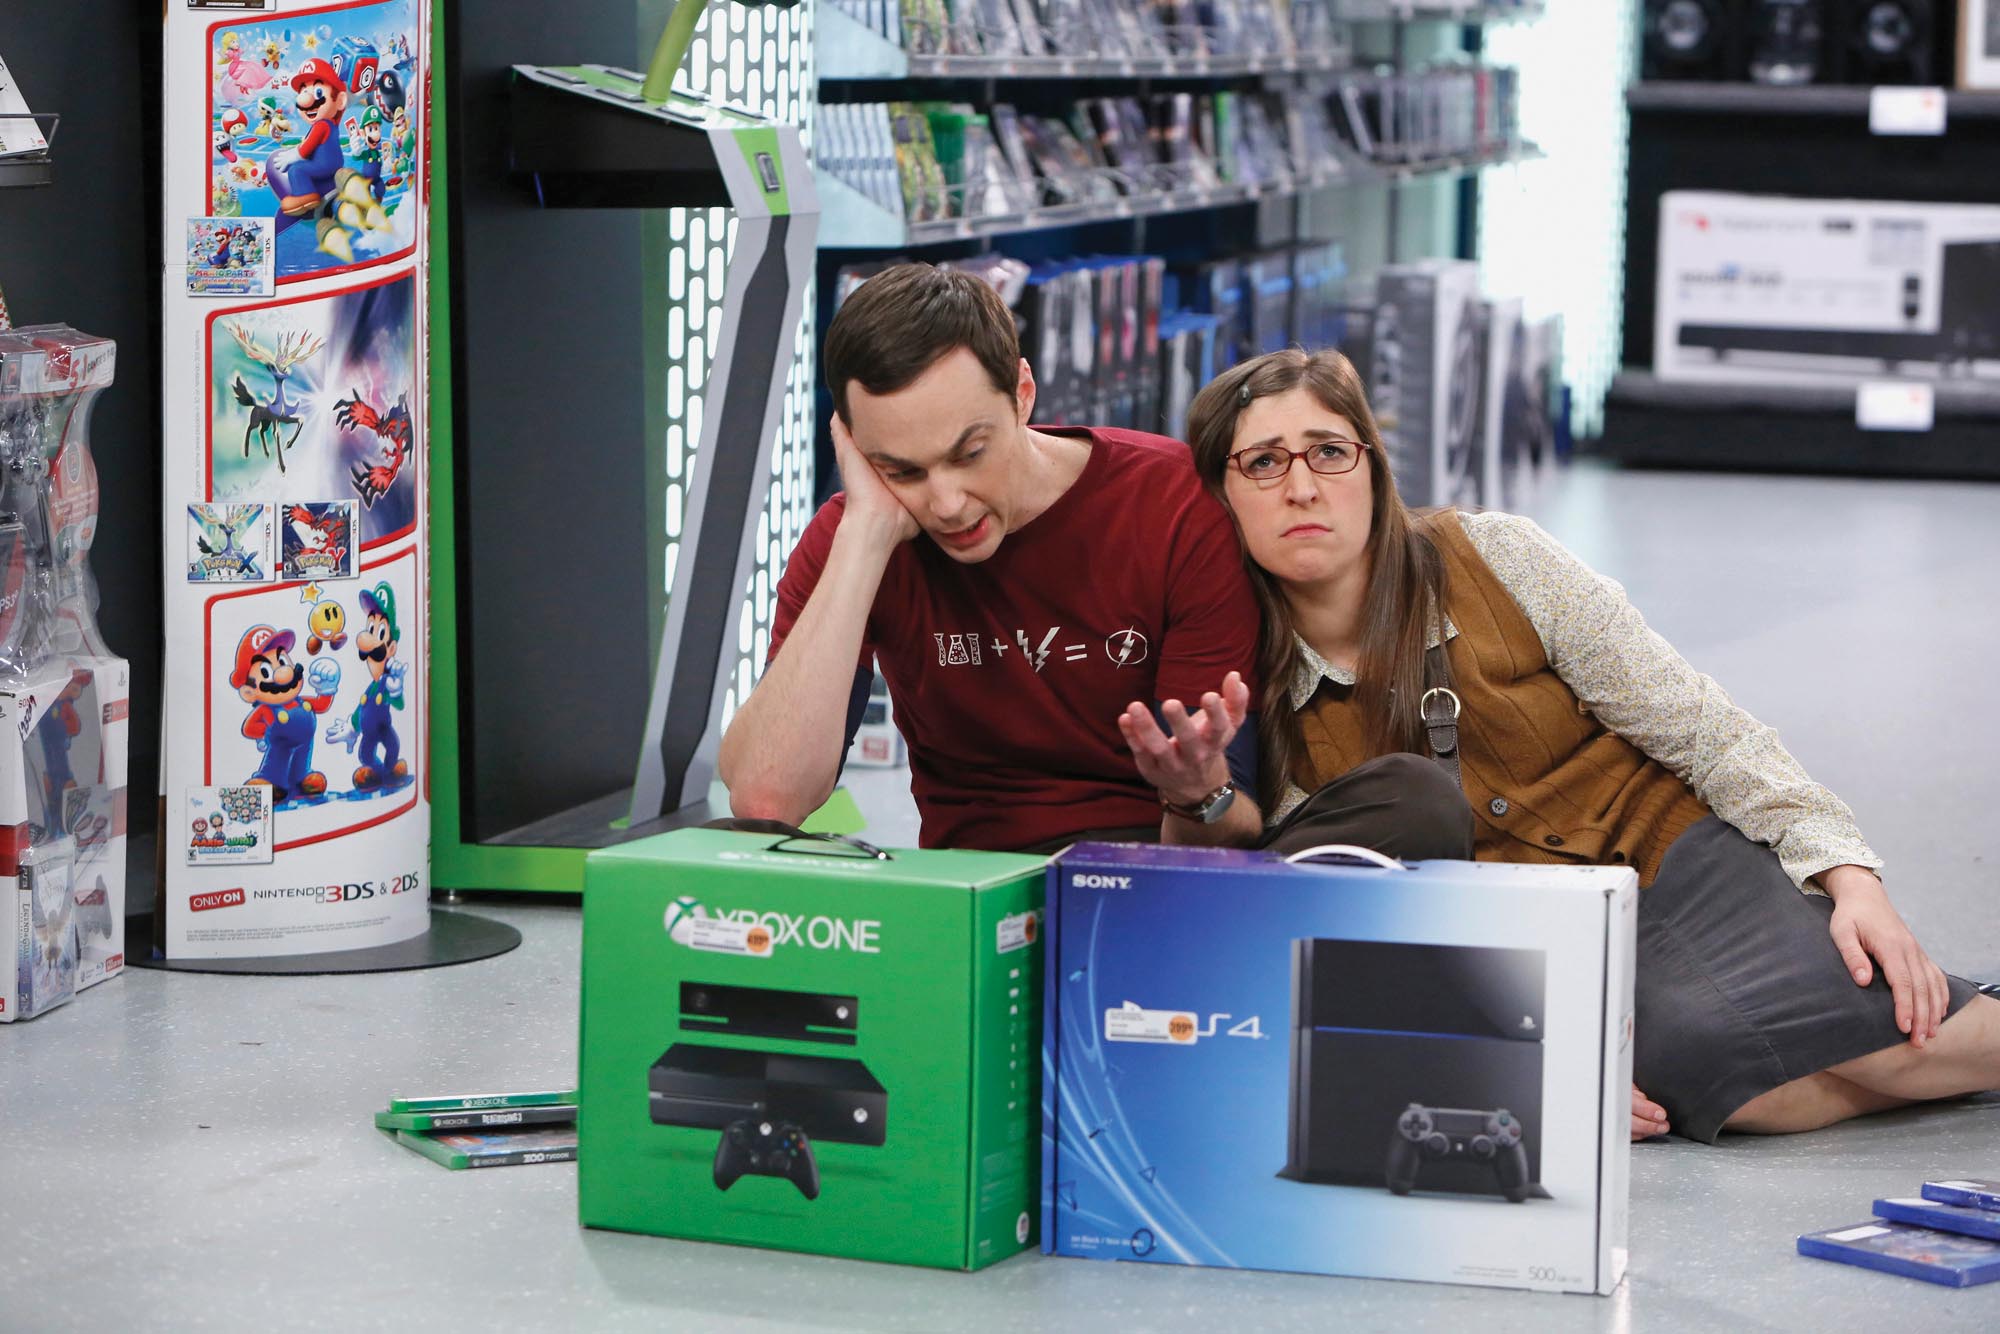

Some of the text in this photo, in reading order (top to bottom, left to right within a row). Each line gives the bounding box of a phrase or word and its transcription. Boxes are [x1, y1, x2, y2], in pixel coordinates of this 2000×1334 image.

[327, 547, 347, 572] Y
[193, 896, 221, 909] ONLY
[223, 892, 241, 904] ON
[325, 881, 375, 904] 3DS
[379, 882, 387, 895] &
[391, 871, 420, 895] 2DS
[1072, 874, 1132, 890] SONY
[807, 916, 882, 953] ONE
[472, 1097, 509, 1107] XBOX ONE
[523, 1152, 545, 1163] ZOO
[1528, 1265, 1557, 1281] 500
